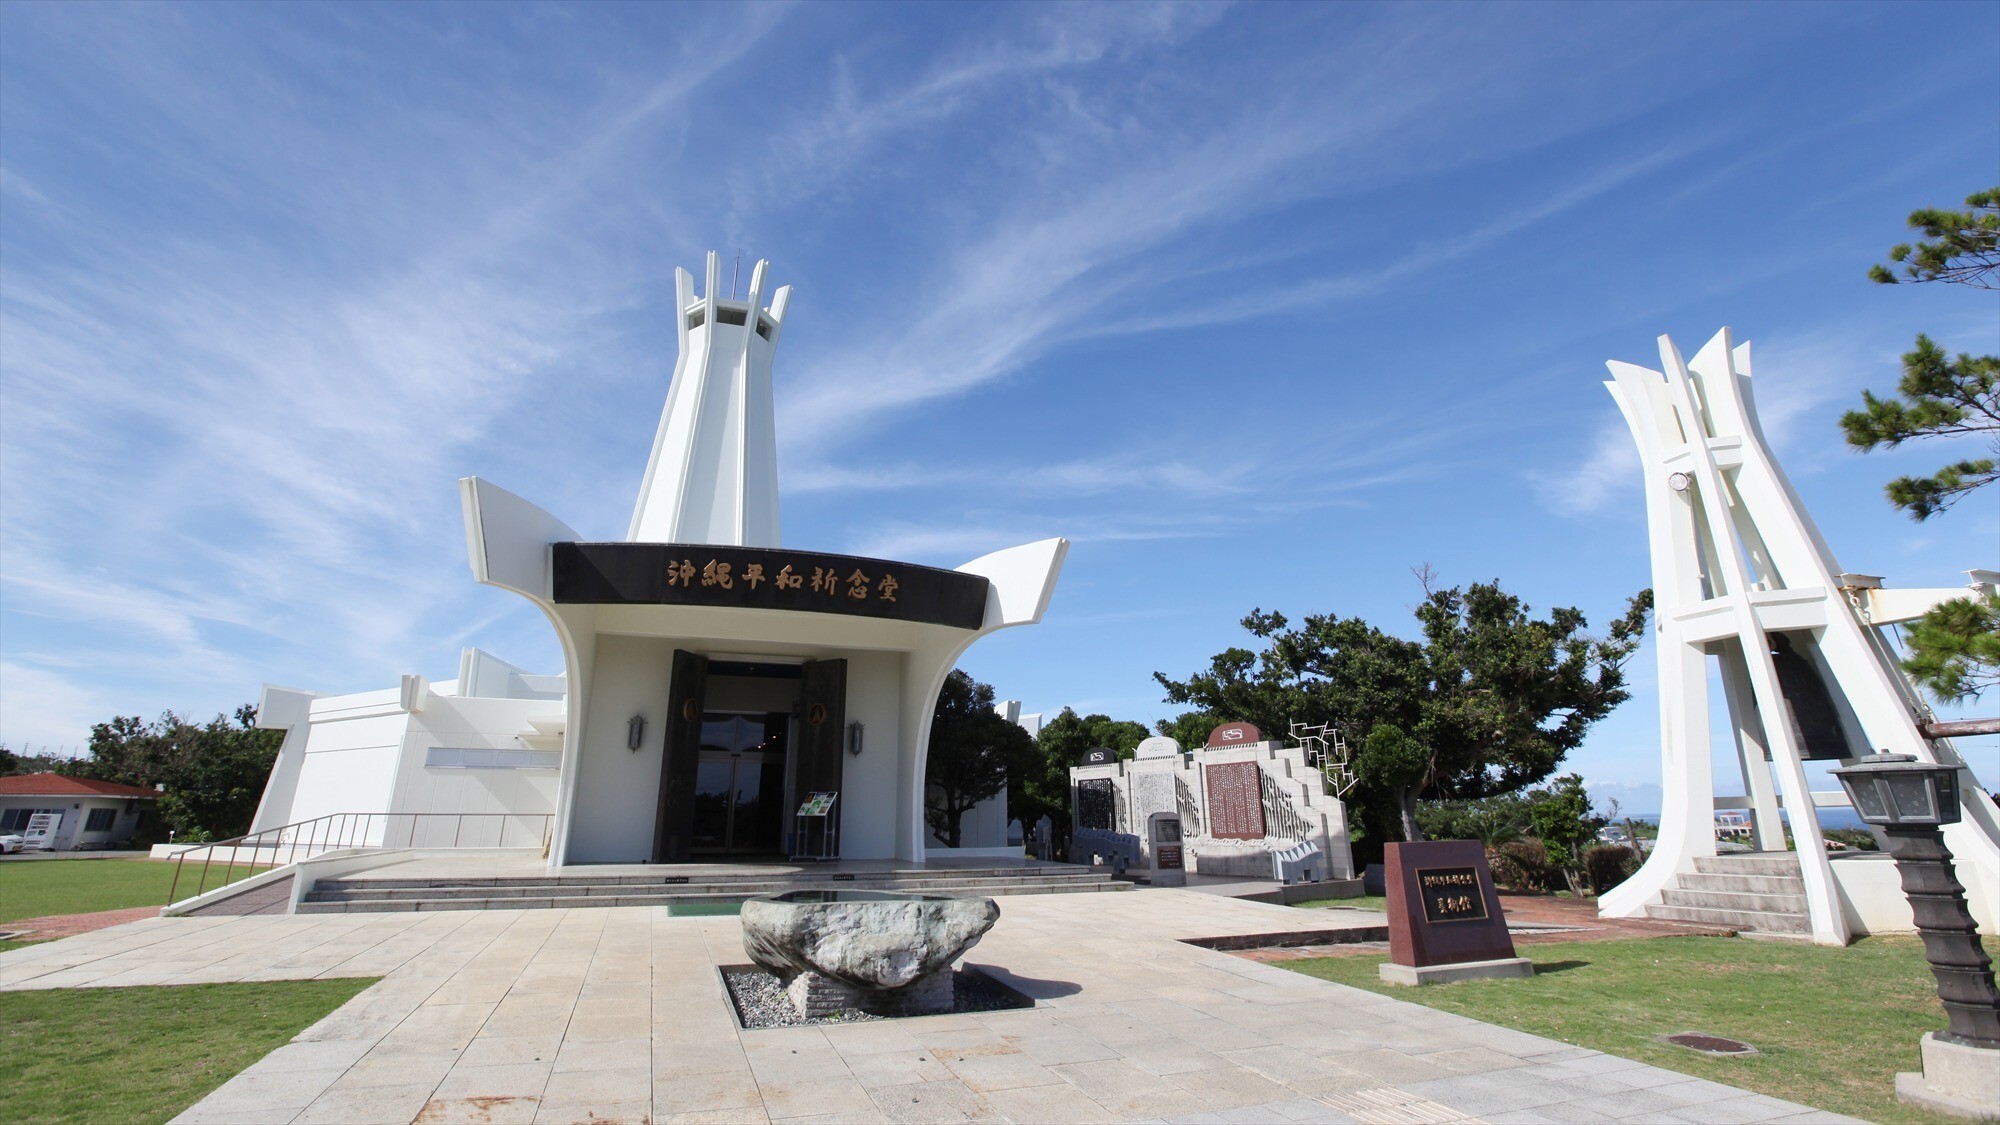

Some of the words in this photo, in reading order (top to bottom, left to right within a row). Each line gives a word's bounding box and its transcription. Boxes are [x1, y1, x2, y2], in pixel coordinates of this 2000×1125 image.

[668, 559, 898, 602] 沖縄平和祈念堂
